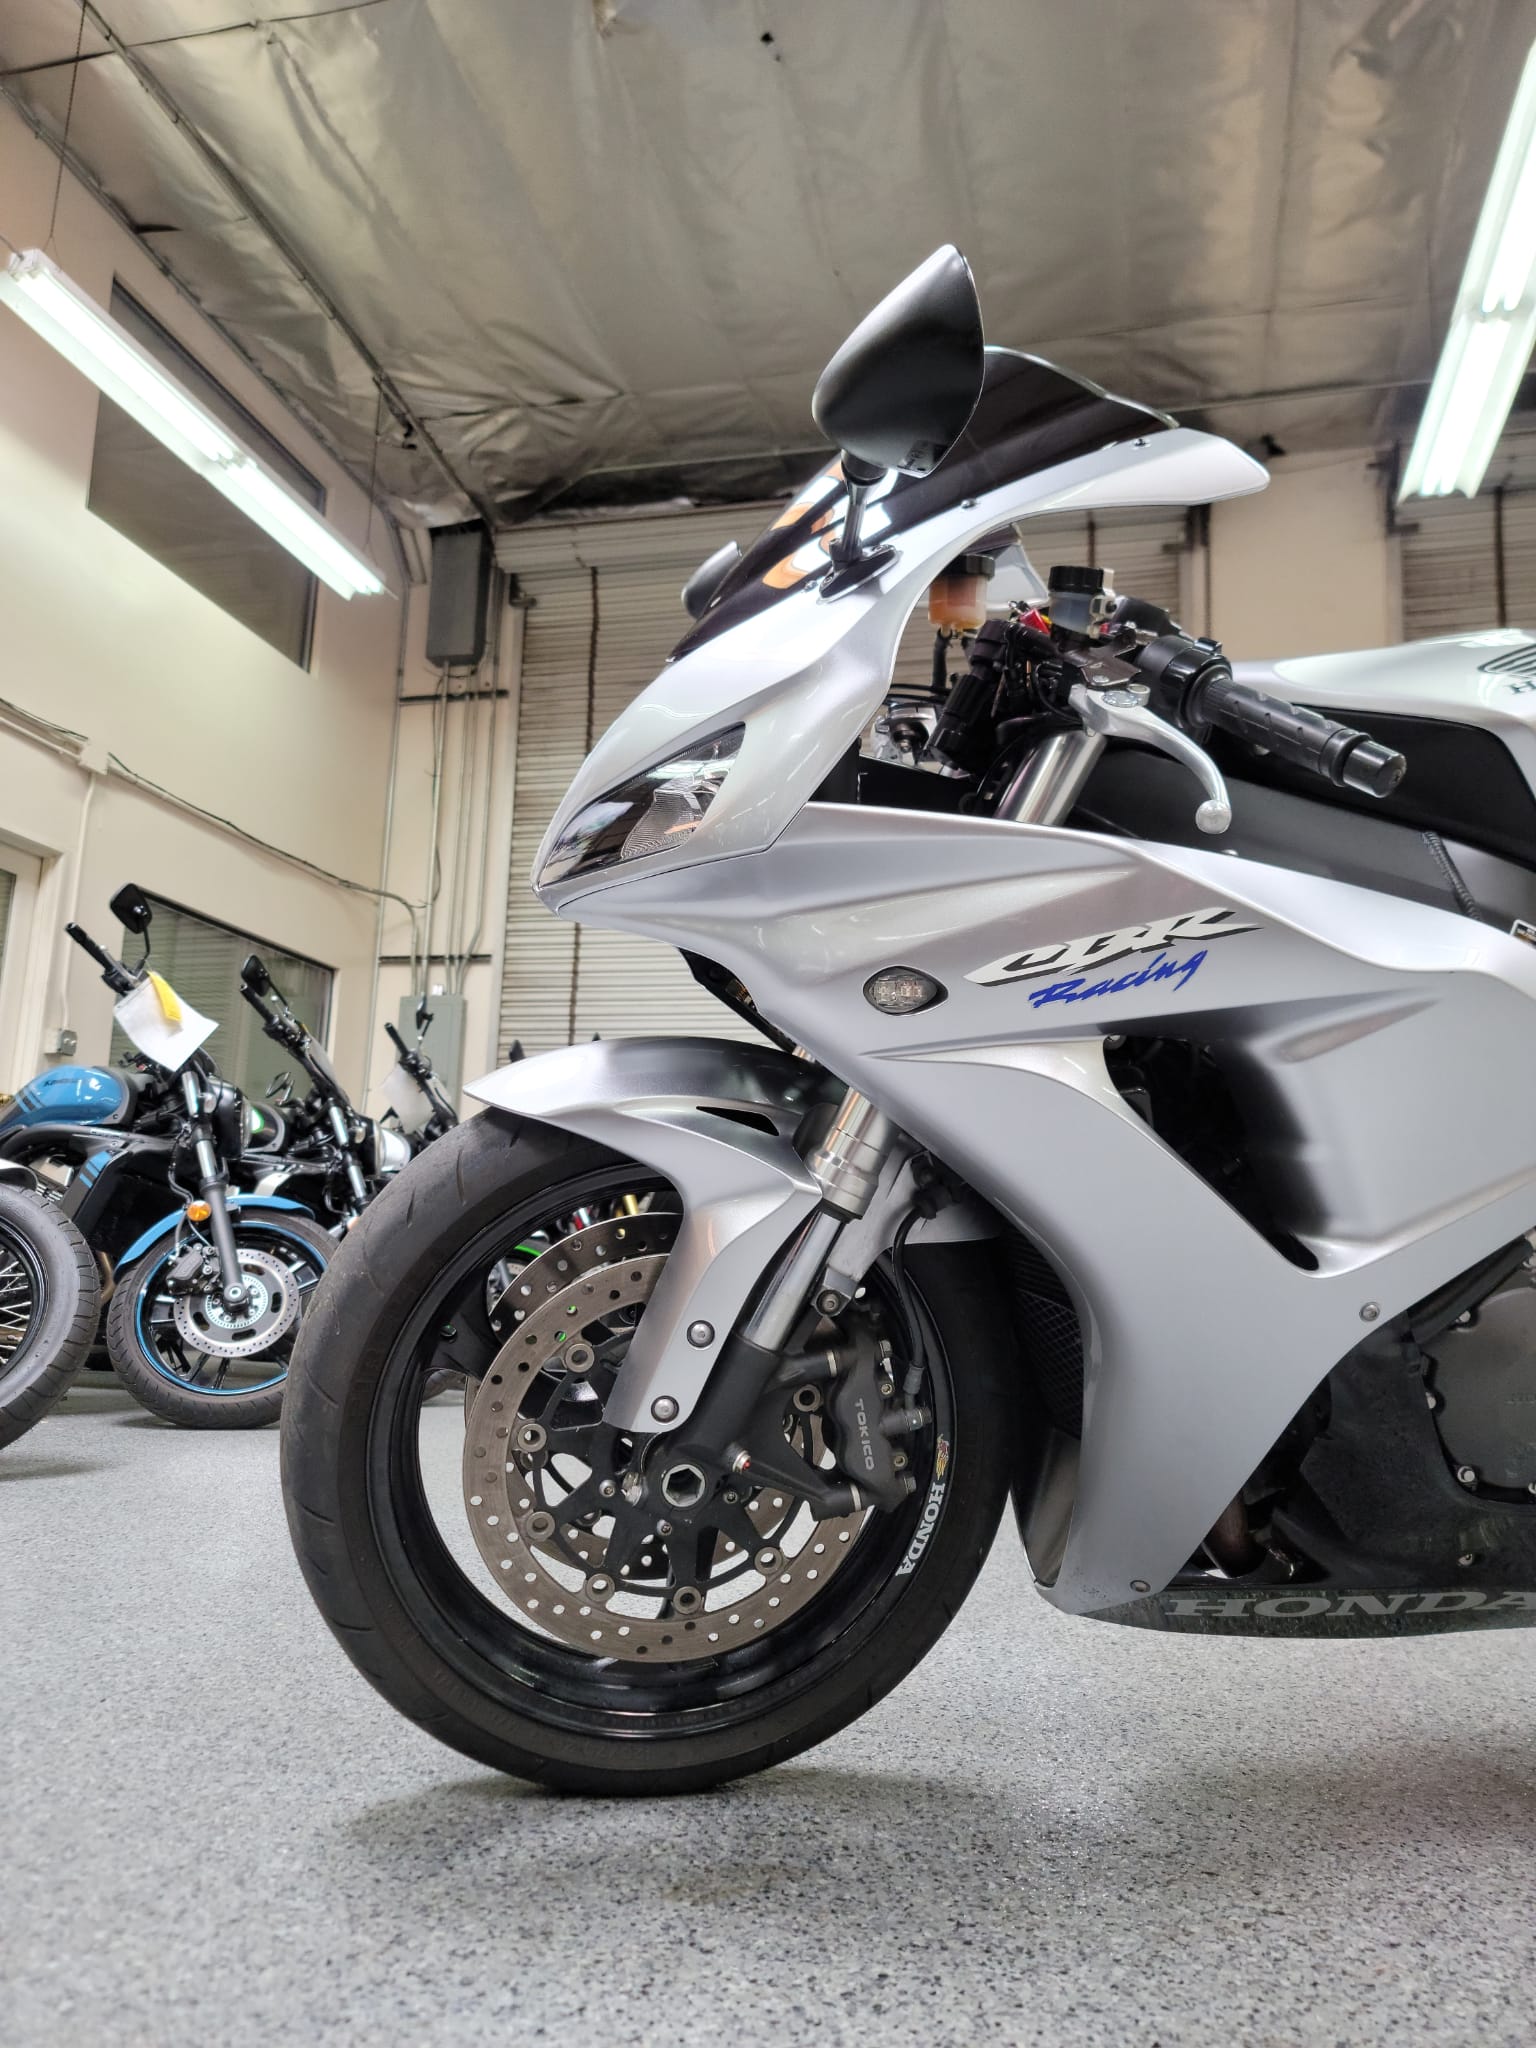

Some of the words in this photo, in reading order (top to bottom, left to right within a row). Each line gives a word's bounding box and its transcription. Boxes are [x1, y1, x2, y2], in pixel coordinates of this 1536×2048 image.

[963, 907, 1262, 987] CBR
[1028, 950, 1209, 1008] Racing
[853, 1398, 875, 1471] TOKICO
[895, 1482, 946, 1576] HONDA
[1164, 1590, 1536, 1619] HONDA
